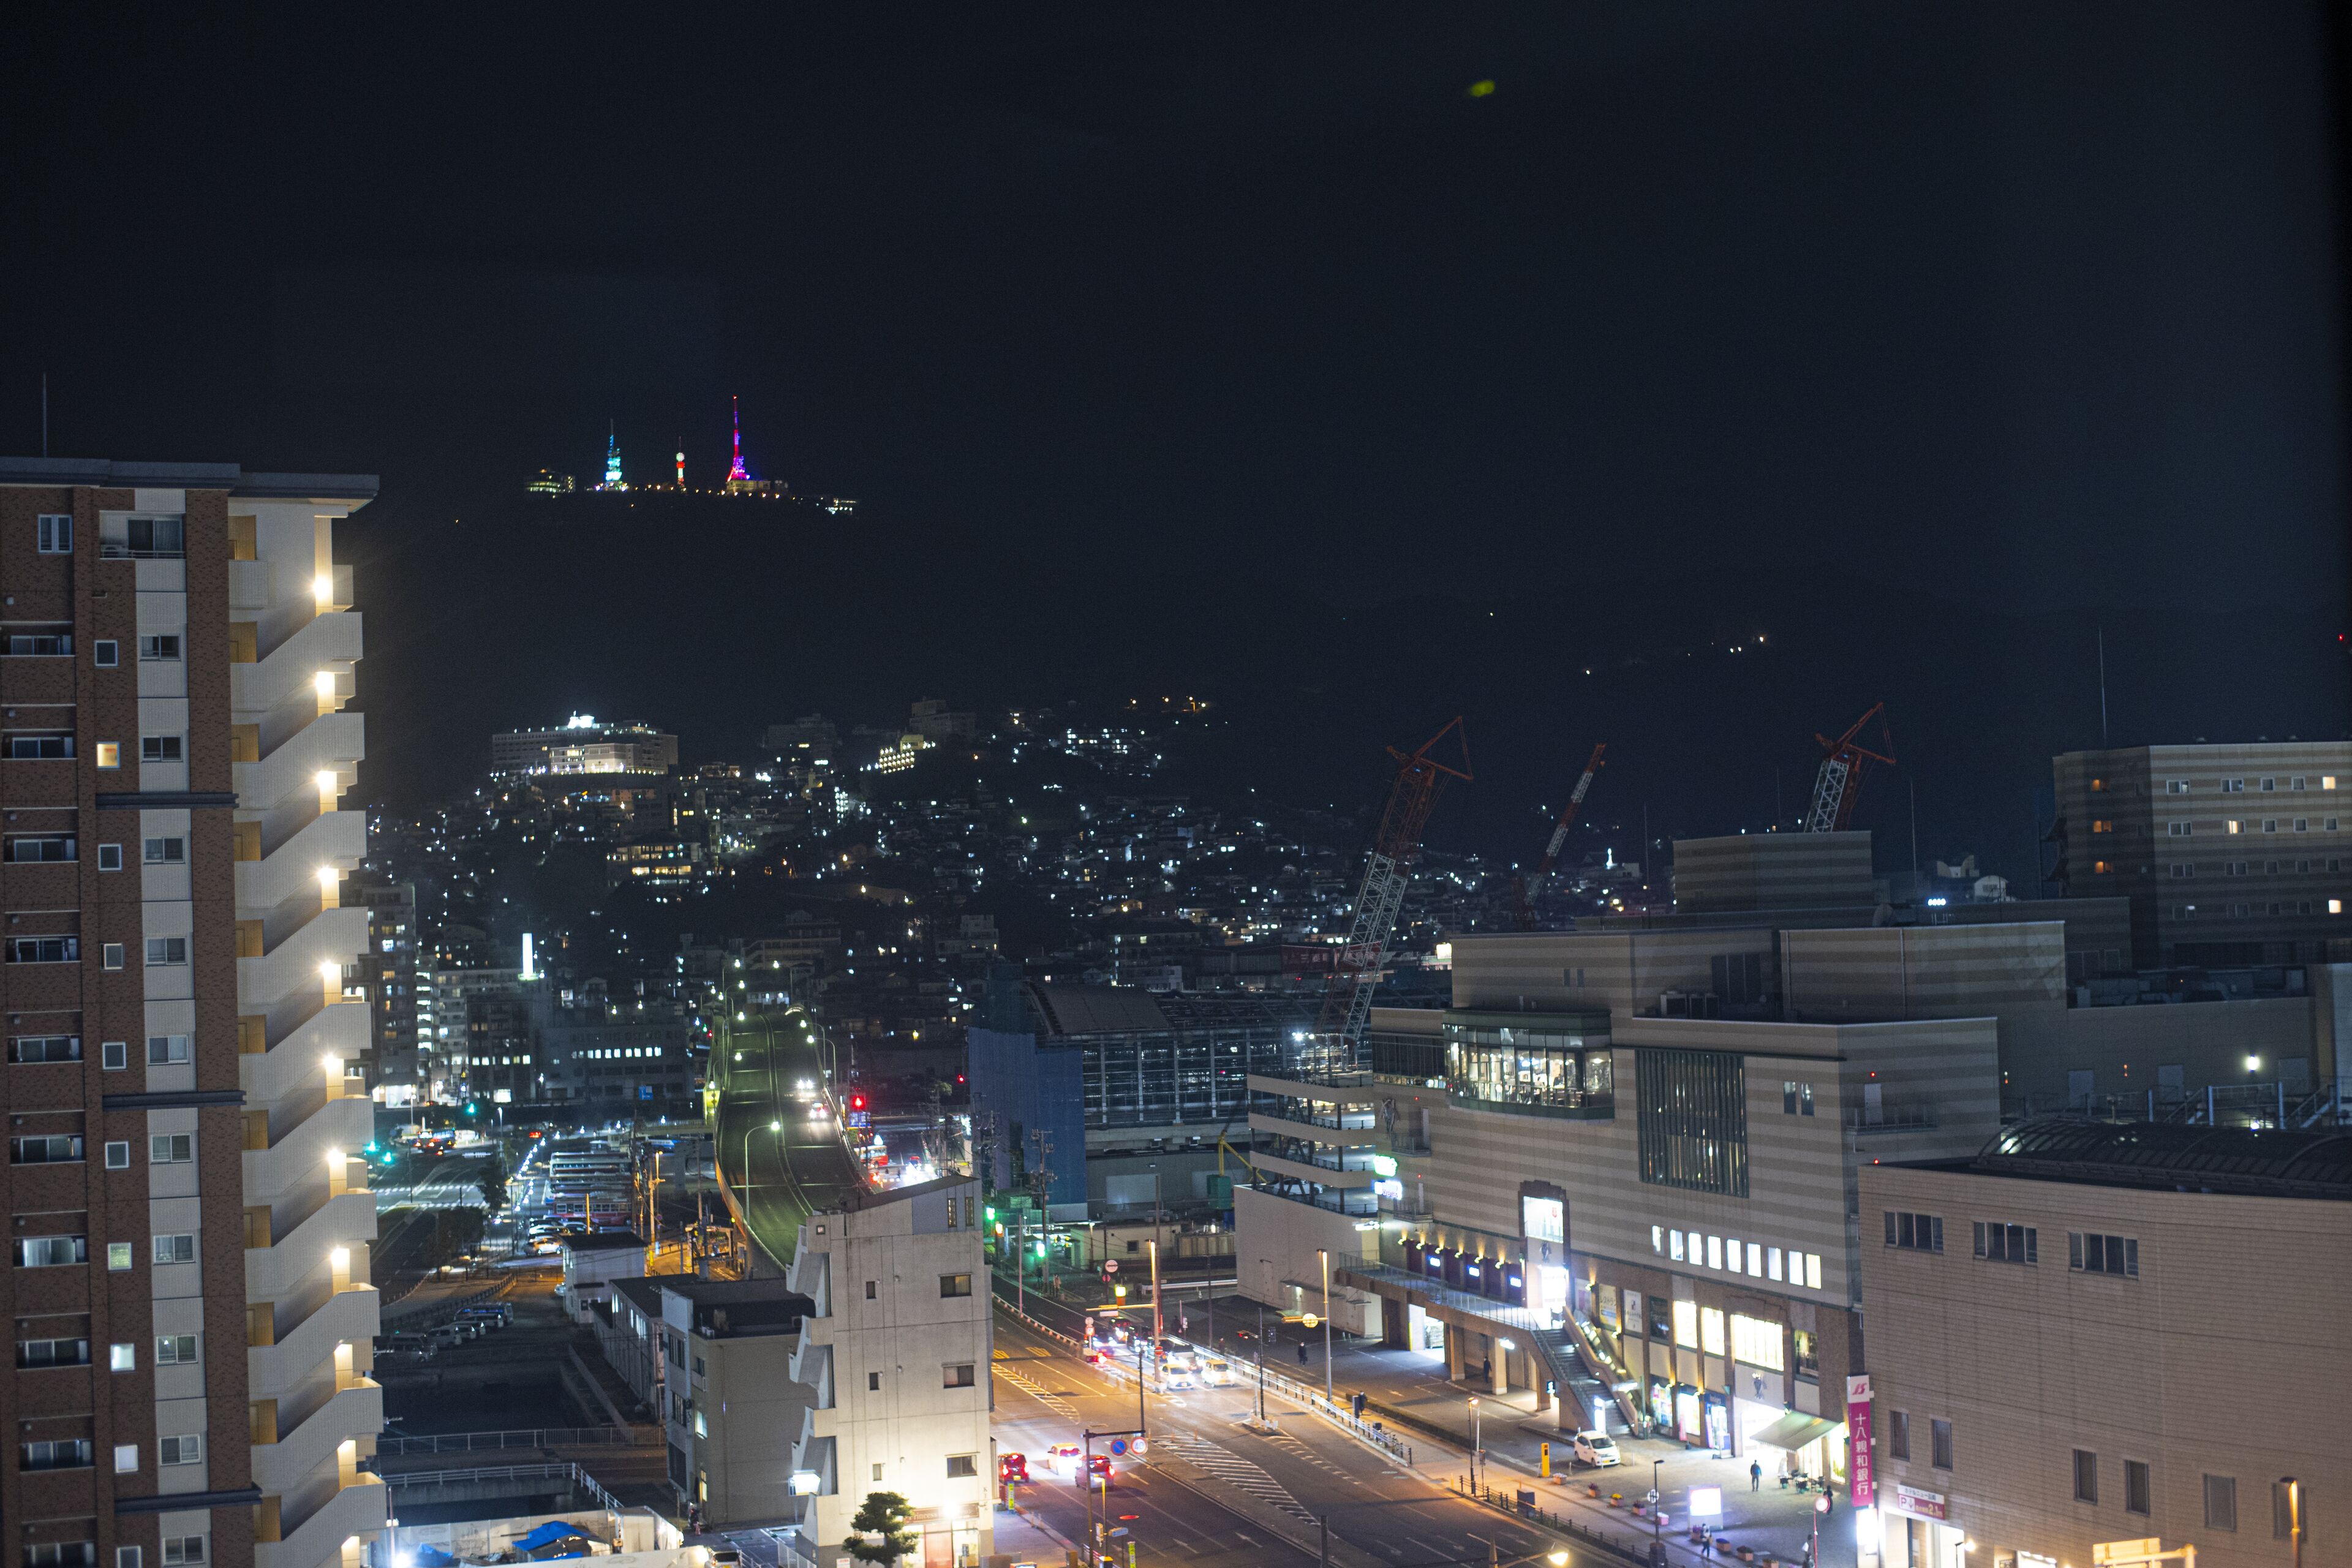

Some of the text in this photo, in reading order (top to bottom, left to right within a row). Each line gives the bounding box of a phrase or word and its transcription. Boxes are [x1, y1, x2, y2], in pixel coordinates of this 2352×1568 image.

[1854, 1412, 1869, 1496] 十八親和銀行
[1901, 1497, 1907, 1507] P
